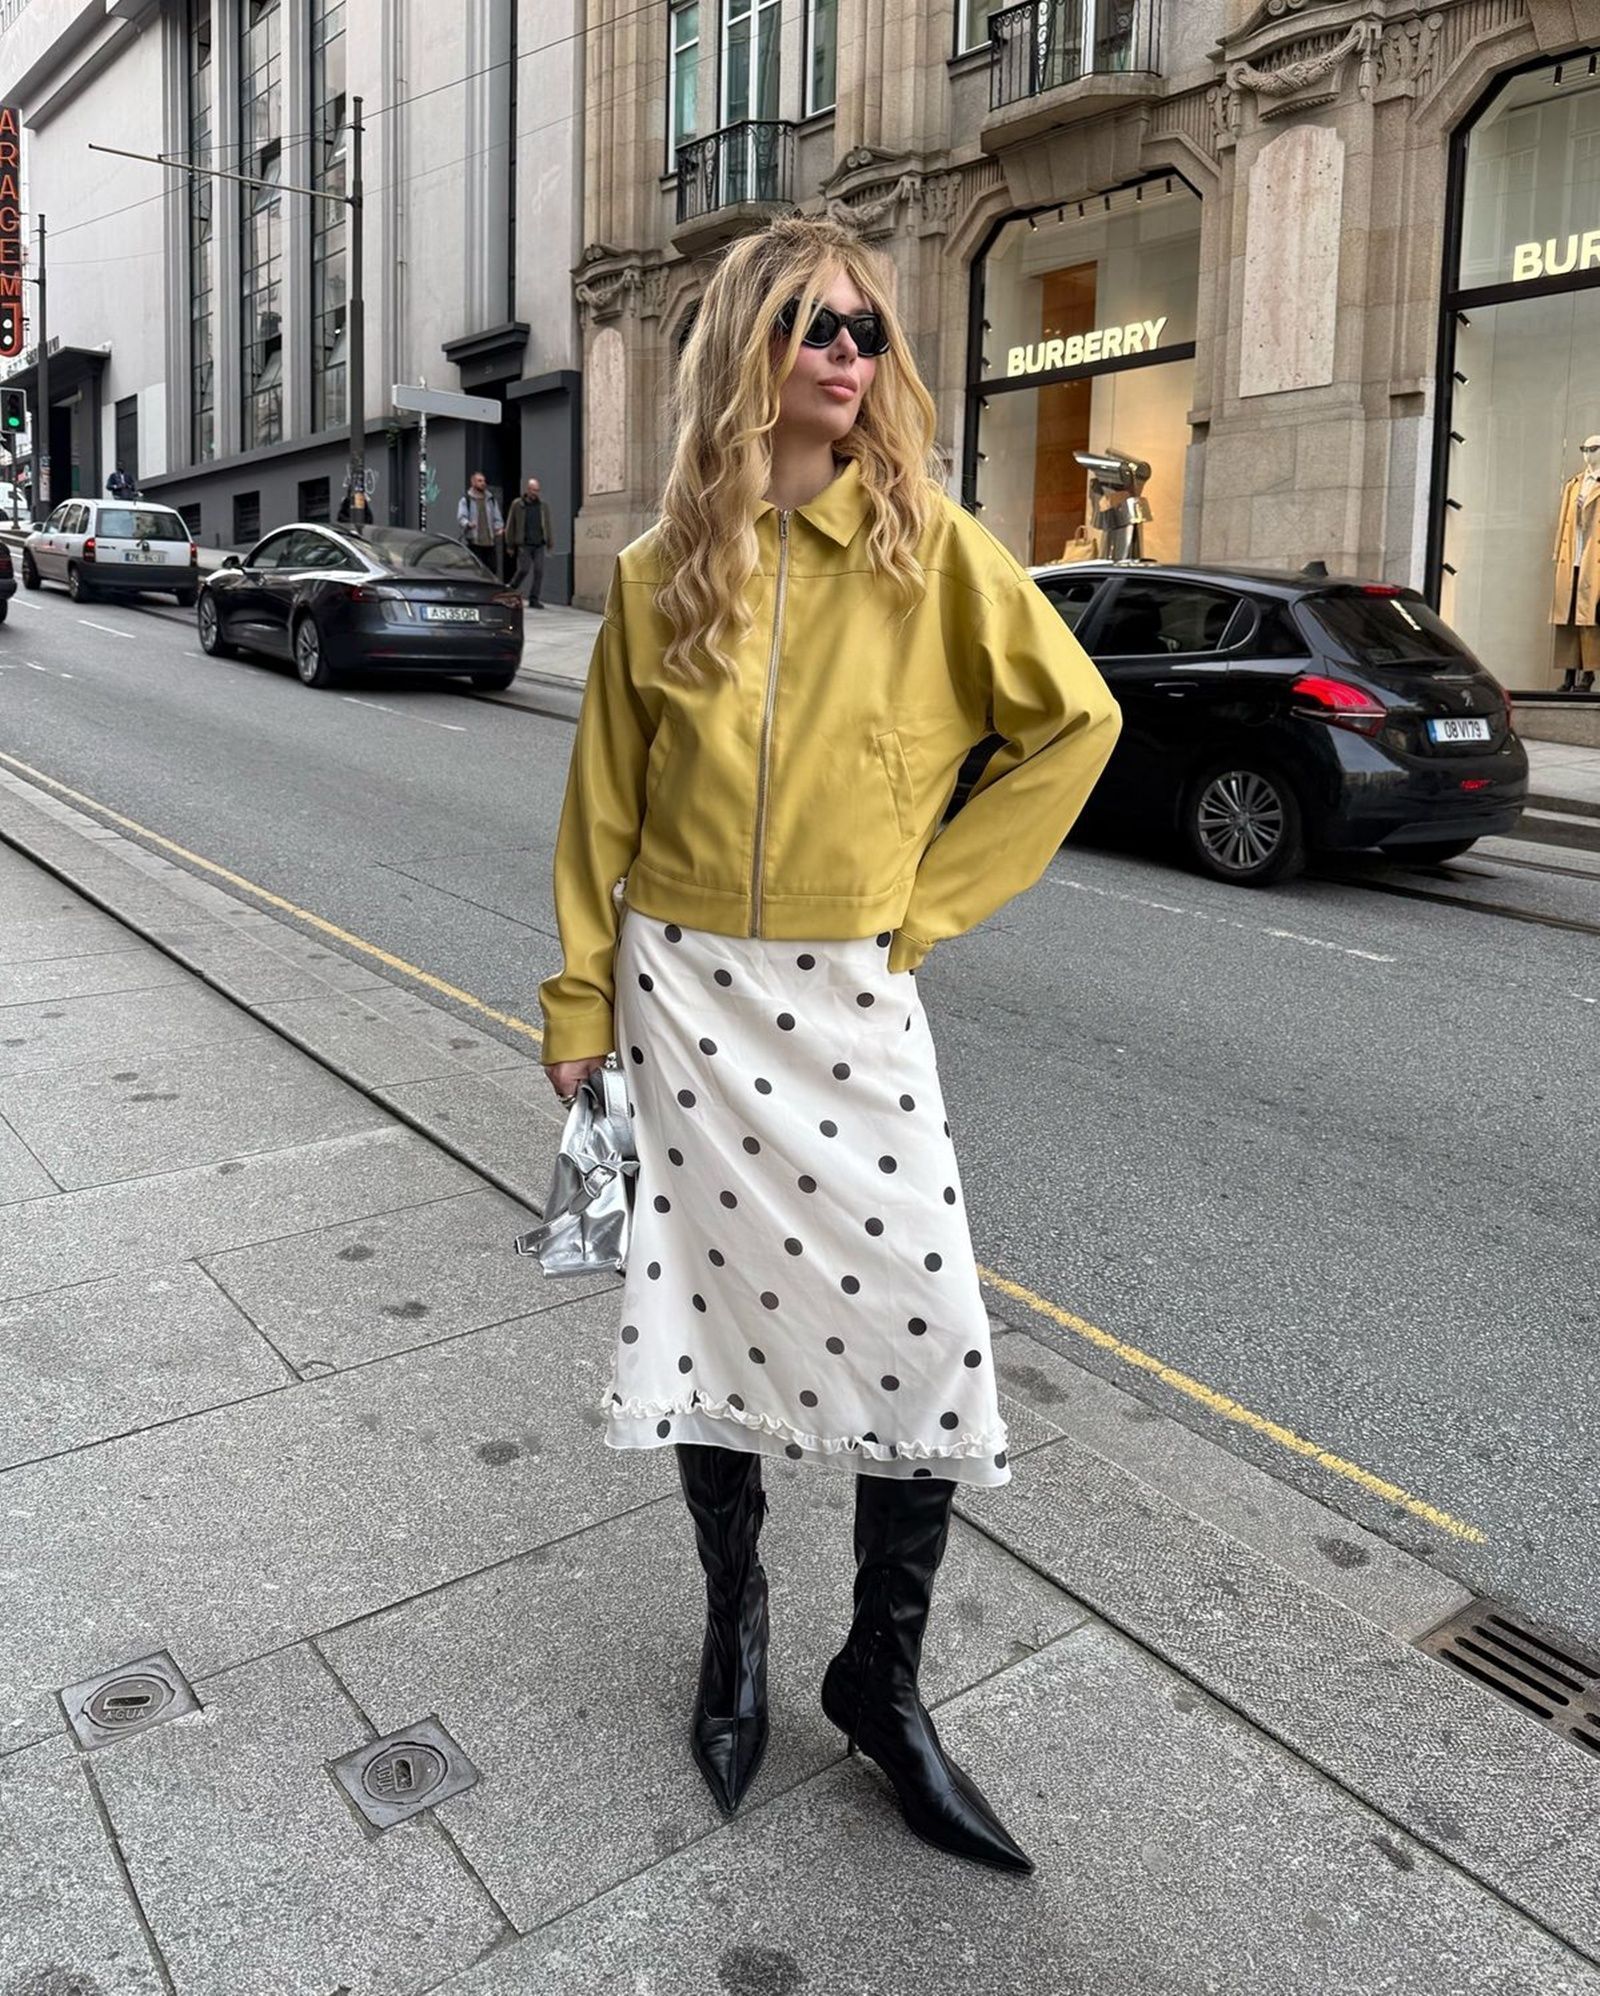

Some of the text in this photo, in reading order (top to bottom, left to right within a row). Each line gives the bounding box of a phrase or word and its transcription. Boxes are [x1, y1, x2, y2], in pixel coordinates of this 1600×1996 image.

[1513, 230, 1600, 282] BUR
[1007, 316, 1167, 378] BURBERRY
[103, 1708, 146, 1722] AGUA
